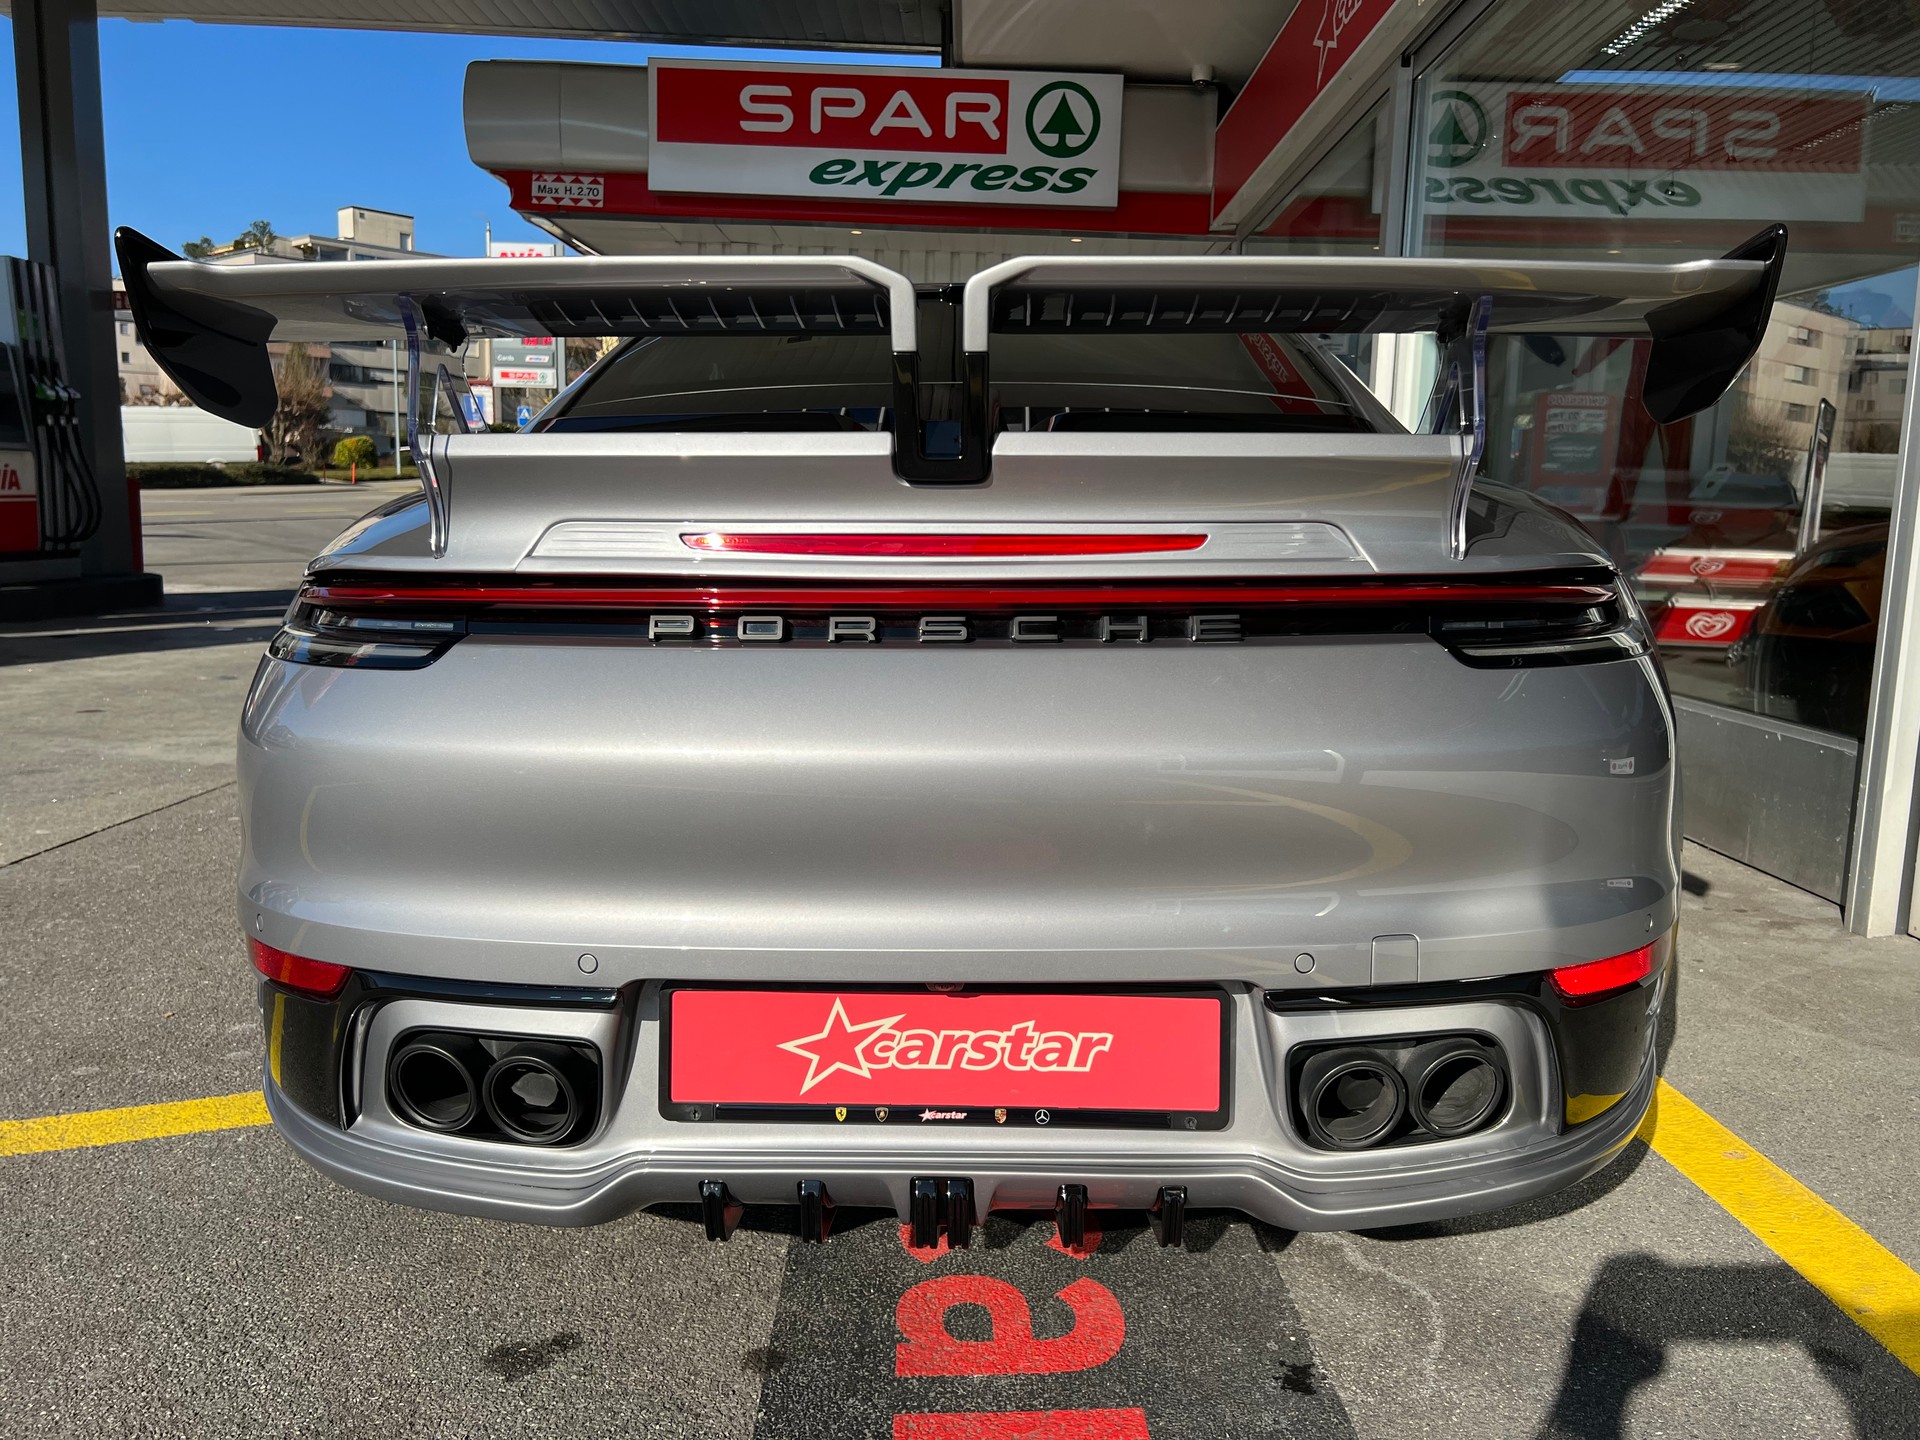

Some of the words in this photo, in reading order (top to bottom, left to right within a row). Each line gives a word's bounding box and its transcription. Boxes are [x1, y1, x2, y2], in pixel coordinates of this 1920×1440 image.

[739, 84, 1001, 141] SPAR
[537, 184, 560, 195] Max
[808, 158, 1099, 196] express
[508, 372, 538, 381] SPAR
[648, 614, 1243, 643] PORSCHE
[862, 1020, 1114, 1072] carstar
[930, 1110, 967, 1120] carstar
